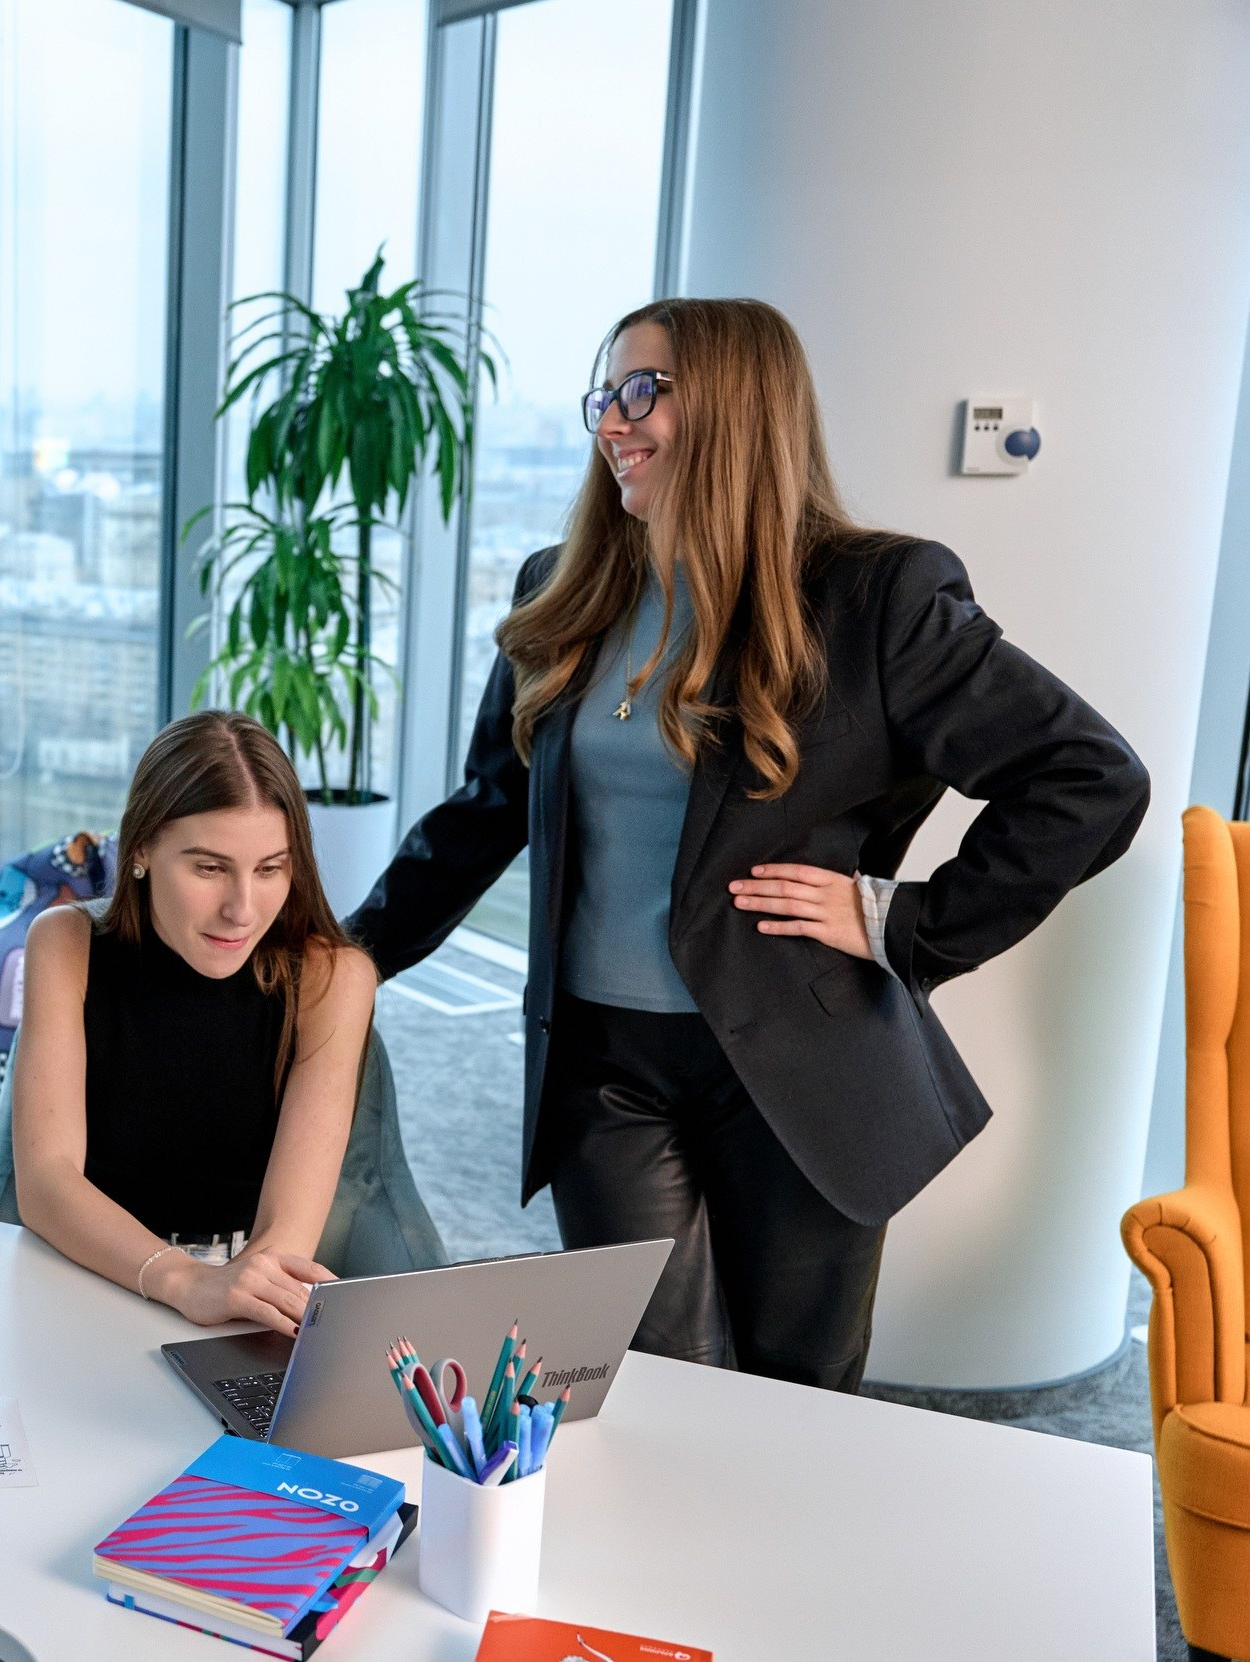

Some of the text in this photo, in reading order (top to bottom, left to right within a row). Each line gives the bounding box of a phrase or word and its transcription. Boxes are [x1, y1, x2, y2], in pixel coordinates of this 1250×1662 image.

[309, 1302, 321, 1326] Lenovo
[541, 1363, 610, 1388] ThinkBook
[276, 1481, 360, 1513] OZON
